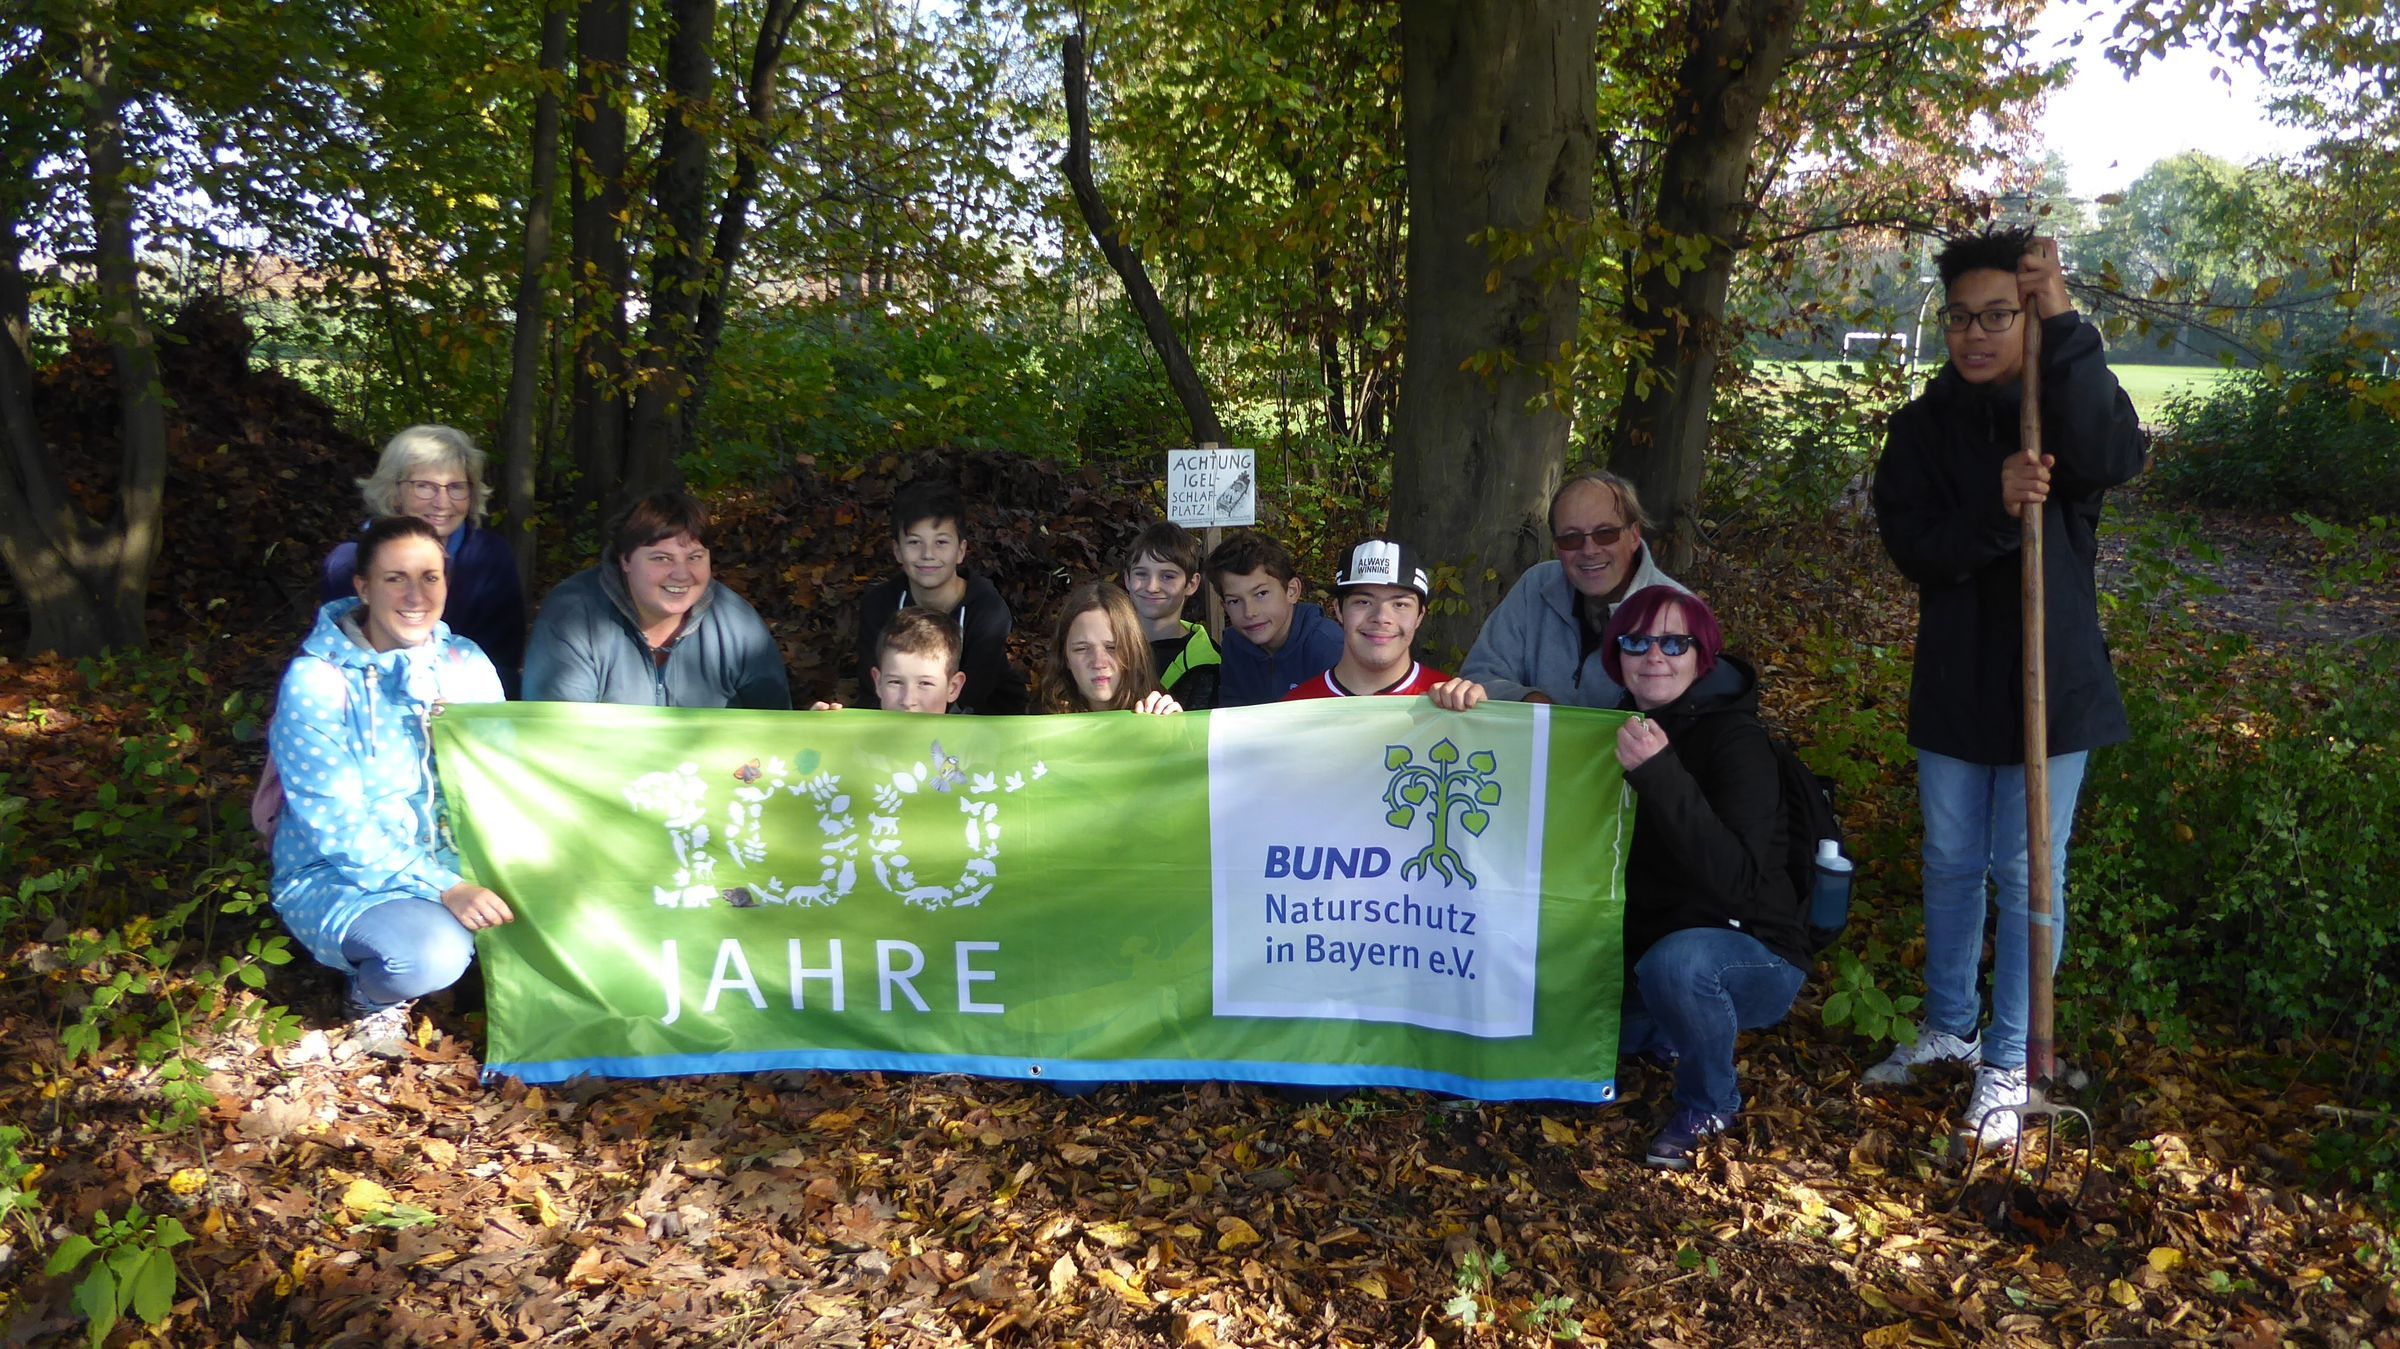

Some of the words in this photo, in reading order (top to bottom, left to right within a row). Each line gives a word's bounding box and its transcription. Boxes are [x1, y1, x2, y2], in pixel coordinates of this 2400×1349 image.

[1173, 454, 1251, 471] ACHTUNG
[1171, 504, 1210, 517] PLATZ!
[1358, 557, 1390, 567] ALWAYS
[1358, 565, 1390, 575] WINNING
[1264, 844, 1391, 881] BUND
[1265, 893, 1476, 935] Naturschutz
[1265, 936, 1294, 964] in
[1305, 933, 1419, 971] Bayern
[1428, 946, 1476, 980] e.V.
[660, 937, 1005, 1025] JAHRE
